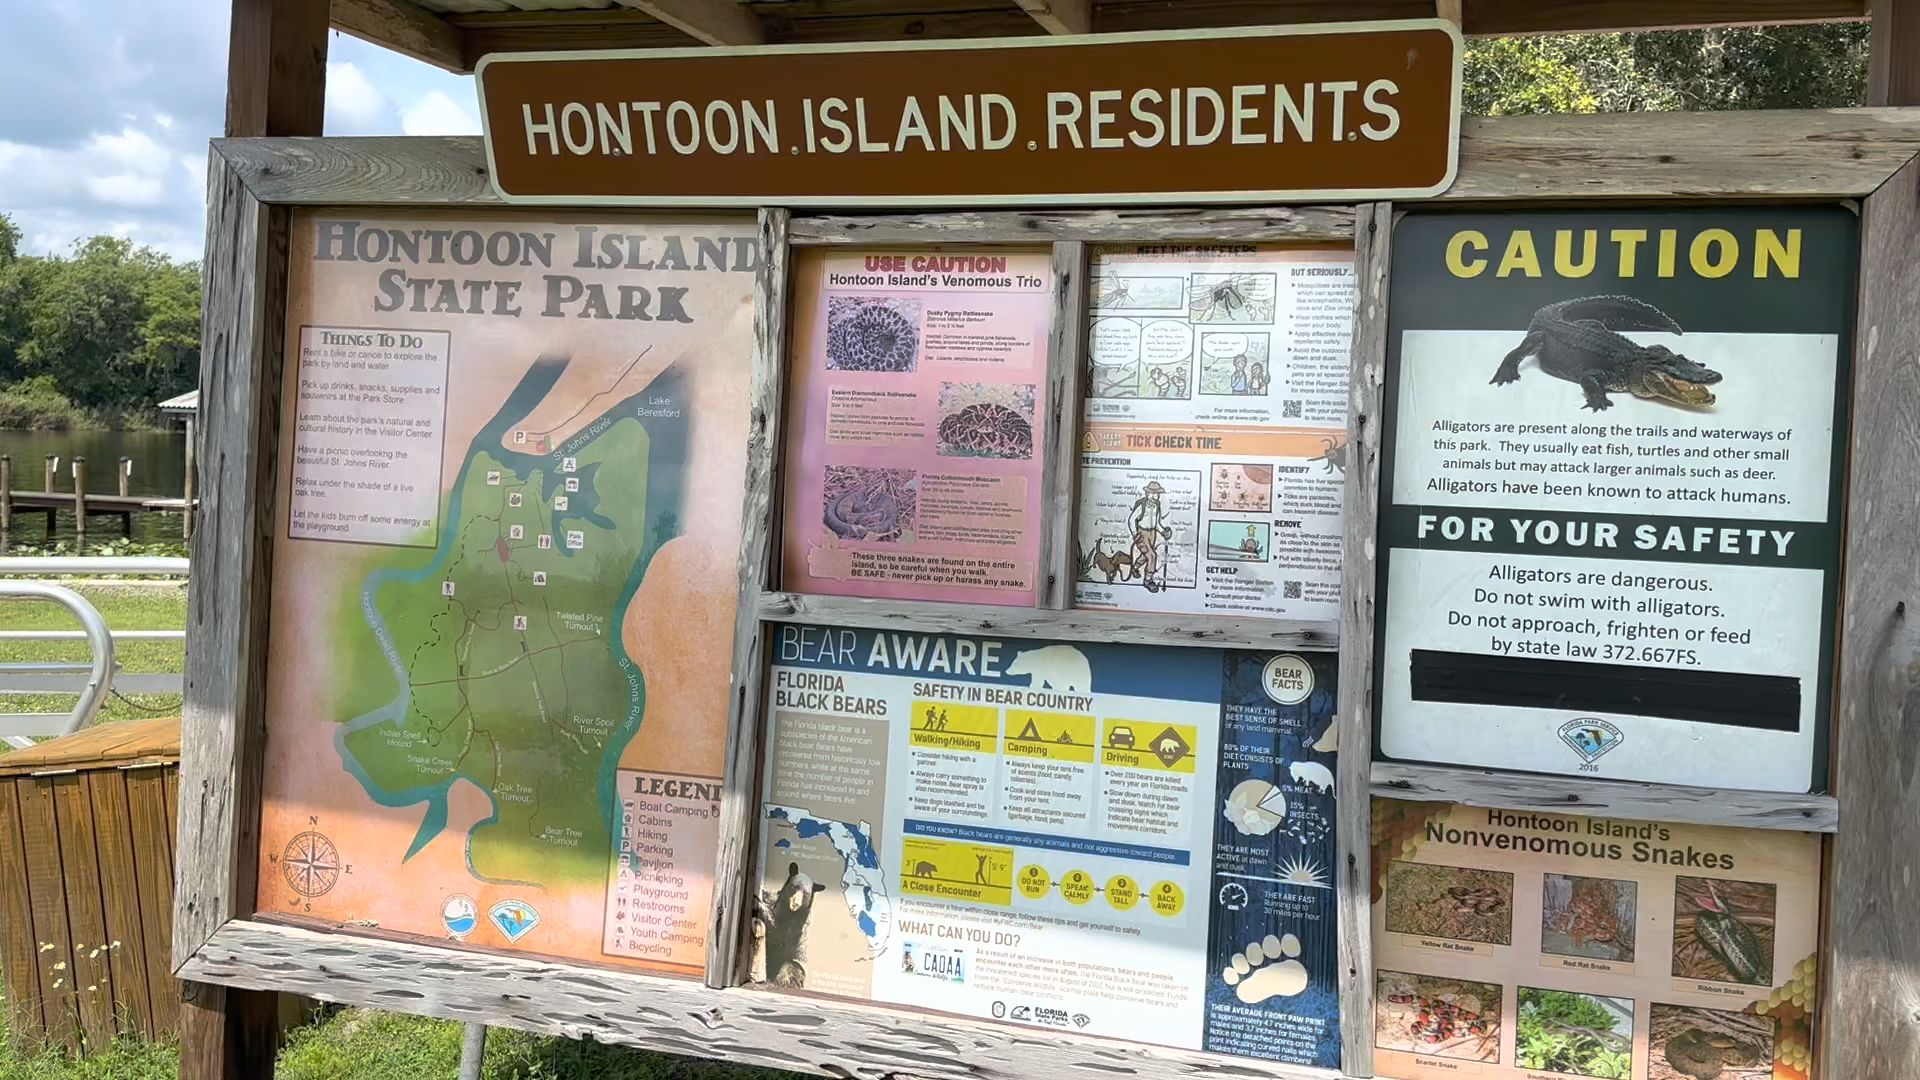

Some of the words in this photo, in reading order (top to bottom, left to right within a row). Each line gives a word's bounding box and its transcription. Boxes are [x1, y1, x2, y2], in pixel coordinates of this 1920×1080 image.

[522, 98, 780, 156] HONTOON
[803, 93, 1018, 154] ISLAND
[1046, 79, 1401, 150] RESIDENTS
[314, 221, 556, 268] HONTOON
[1445, 228, 1801, 278] CAUTION
[864, 256, 906, 272] USE
[911, 256, 1006, 273] CAUTION
[829, 272, 883, 288] Hontoon
[887, 273, 937, 286] Island's
[941, 274, 1011, 287] Venomous
[1015, 275, 1042, 287] Trio
[374, 268, 522, 318] STATE
[541, 274, 694, 323] PARK
[649, 396, 670, 406] Lake
[638, 408, 680, 418] Beresford
[1431, 419, 1490, 434] Alligators
[1493, 423, 1514, 433] are
[1518, 423, 1567, 435] present
[1570, 422, 1607, 437] along
[1610, 423, 1632, 435] the
[1635, 424, 1668, 437] trails
[1671, 426, 1697, 437] and
[1700, 428, 1773, 442] waterways
[1776, 428, 1792, 440] of
[1125, 432, 1151, 447] TICK
[1153, 435, 1192, 448] CHECK
[1195, 436, 1222, 449] TIME
[1433, 438, 1456, 450] this
[1459, 439, 1490, 452] park.
[1498, 440, 1529, 454] They
[1533, 441, 1578, 456] usually
[1581, 444, 1602, 454] eat
[1606, 442, 1632, 457] fish,
[1636, 444, 1680, 456] turtles
[1683, 446, 1709, 457] and
[1712, 446, 1750, 459] other
[1753, 448, 1789, 460] small
[1278, 465, 1310, 473] IDENTIFY
[1442, 458, 1491, 470] animals
[1494, 458, 1516, 470] but
[1519, 462, 1547, 474] may
[1550, 461, 1589, 473] attack
[1593, 461, 1632, 476] larger
[1634, 464, 1686, 476] animals
[1689, 465, 1720, 478] such
[1724, 469, 1738, 478] as
[1742, 467, 1775, 480] deer.
[1426, 477, 1497, 494] Alligators
[1502, 479, 1538, 494] have
[1543, 480, 1582, 496] been
[1588, 482, 1639, 500] known
[1645, 486, 1661, 499] to
[1666, 487, 1715, 501] attack
[1720, 487, 1790, 504] humans.
[1274, 519, 1301, 528] REMOVE
[1417, 514, 1494, 541] FOR
[1509, 518, 1618, 547] YOUR
[1633, 524, 1795, 556] SAFETY
[1219, 566, 1238, 574] HELP
[1488, 564, 1571, 584] Alligators
[1576, 572, 1605, 585] are
[1611, 570, 1712, 591] dangerous.
[1474, 587, 1498, 603] Do
[1503, 592, 1533, 605] not
[1538, 593, 1584, 608] swim
[1590, 595, 1630, 611] with
[1636, 597, 1724, 617] alligators.
[1448, 610, 1471, 626] Do
[1477, 615, 1506, 628] not
[1511, 617, 1600, 637] approach,
[1606, 619, 1678, 640] frighten
[1684, 629, 1705, 641] or
[1710, 626, 1750, 644] feed
[781, 626, 856, 665] BEAR
[866, 633, 1001, 677] AWARE
[1491, 637, 1512, 656] by
[1516, 640, 1559, 655] state
[1566, 640, 1596, 656] law
[1602, 644, 1700, 665] 372.667FS.
[1274, 666, 1302, 680] BEAR
[775, 670, 844, 692] FLORIDA
[1271, 677, 1304, 690] FACTS
[774, 690, 829, 711] BLACK
[832, 694, 887, 715] BEARS
[912, 682, 965, 700] SAFETY
[967, 686, 981, 701] IN
[984, 687, 1023, 705] BEAR
[1026, 691, 1093, 712] COUNTRY
[913, 732, 980, 750] Walking/Hiking
[1007, 741, 1047, 756] Camping
[1105, 751, 1139, 766] Driving
[1578, 764, 1599, 772] 2016
[634, 777, 722, 801] LEGEN
[640, 801, 662, 812] Boat
[665, 803, 708, 818] Camping
[309, 816, 318, 825] N
[638, 815, 672, 827] Cabins
[1487, 809, 1578, 833] Hontoon
[1586, 817, 1673, 841] Island's
[638, 829, 668, 842] Hiking
[636, 843, 674, 858] Parking
[1427, 822, 1621, 859] Nonvenomous
[1631, 840, 1734, 870] Snakes
[269, 854, 278, 863] W
[345, 865, 352, 874] E
[901, 879, 908, 889] A
[909, 880, 934, 892] Close
[936, 883, 981, 898] Encounter
[1026, 886, 1040, 894] RUN
[1032, 880, 1045, 888] NOT
[1066, 884, 1089, 892] SPEAK
[633, 885, 688, 901] Playground
[1064, 890, 1090, 900] CALMLY
[1110, 888, 1132, 898] STAND
[1157, 894, 1176, 902] BACK
[304, 903, 311, 912] S
[632, 899, 685, 914] Restrooms
[1112, 897, 1130, 905] TALL
[1156, 902, 1176, 910] AWAY
[632, 913, 661, 926] Visitor
[664, 916, 698, 929] Center
[631, 927, 657, 940] Youth
[660, 930, 704, 946] Camping
[898, 919, 934, 936] WHAT
[937, 924, 962, 939] CAN
[966, 927, 990, 943] YOU
[994, 931, 1020, 947] DO?
[629, 941, 672, 956] Bicycling
[1442, 942, 1453, 951] Rat
[1454, 942, 1474, 952] Snake
[1561, 959, 1577, 969] Red
[1590, 962, 1610, 970] Snake
[1696, 983, 1722, 995] Ribbon
[1722, 985, 1744, 996] Snake
[1034, 1006, 1068, 1017] FLORIDA
